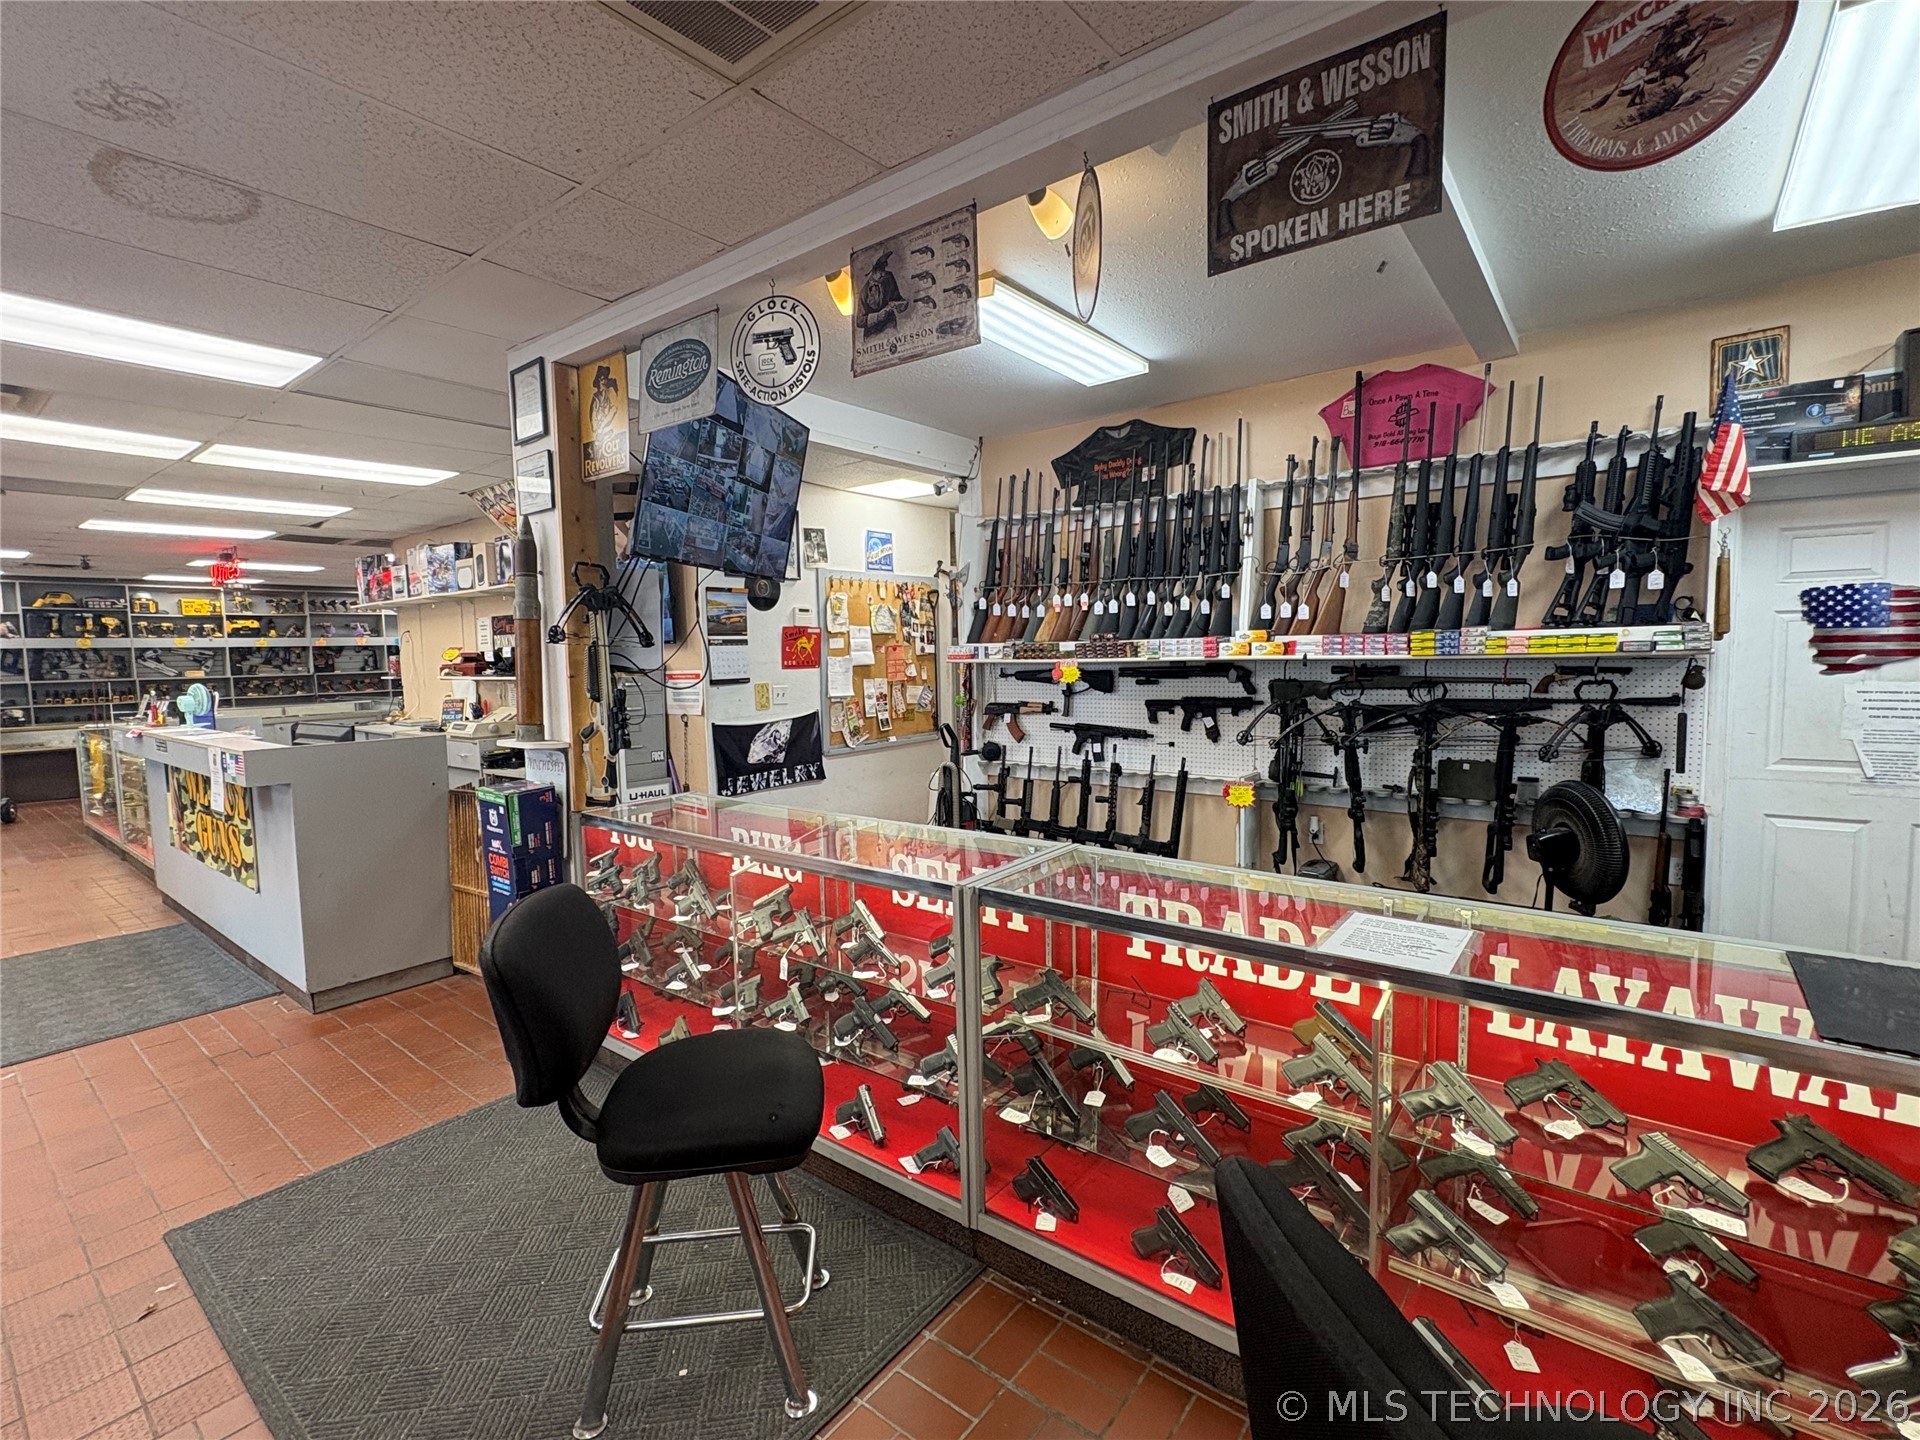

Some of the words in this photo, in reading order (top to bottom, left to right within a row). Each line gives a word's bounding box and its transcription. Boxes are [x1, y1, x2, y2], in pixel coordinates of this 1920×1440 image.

[1218, 84, 1289, 144] SMITH
[1296, 77, 1315, 114] &
[1321, 33, 1431, 106] WESSON
[1563, 116, 1627, 159] FIREARMS
[1230, 207, 1329, 262] SPOKEN
[1338, 183, 1411, 231] HERE
[747, 300, 800, 322] GLOCK
[856, 342, 884, 358] SMITH
[894, 327, 934, 345] WESSON
[648, 355, 709, 389] Remington
[736, 360, 787, 402] SAFE-ACTION
[788, 349, 816, 395] PISTOLS
[602, 439, 620, 457] COLT
[1842, 427, 1876, 447] WE
[584, 452, 626, 477] REVOLVERS
[651, 750, 665, 761] FUCK
[629, 789, 667, 800] U-HAUL
[721, 762, 820, 796] JEWELRY
[196, 811, 242, 868] GUNS
[1119, 892, 1361, 1006] TRADE
